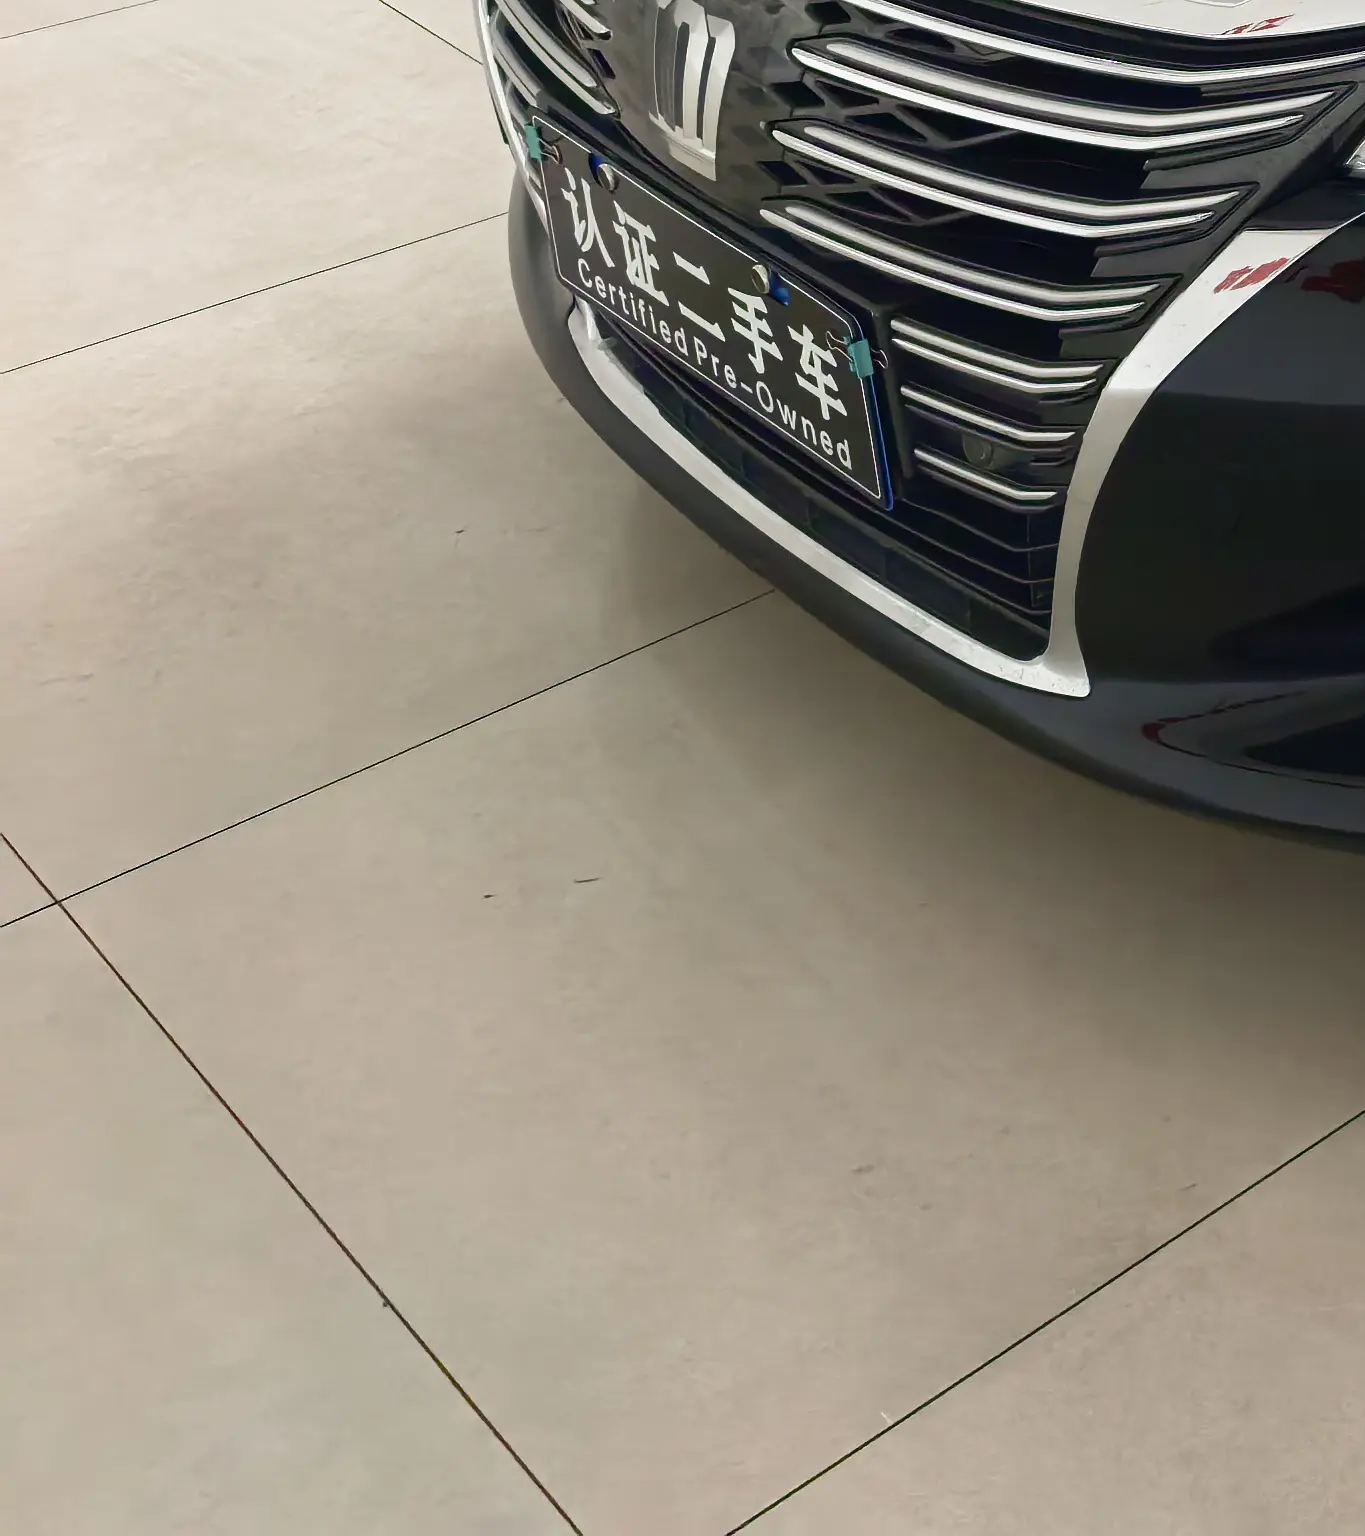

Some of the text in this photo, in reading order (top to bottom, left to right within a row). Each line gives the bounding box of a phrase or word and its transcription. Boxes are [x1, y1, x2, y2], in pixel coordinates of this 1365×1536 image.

[561, 166, 848, 421] 认证二手车
[577, 259, 853, 470] Certified Pre-Owned
